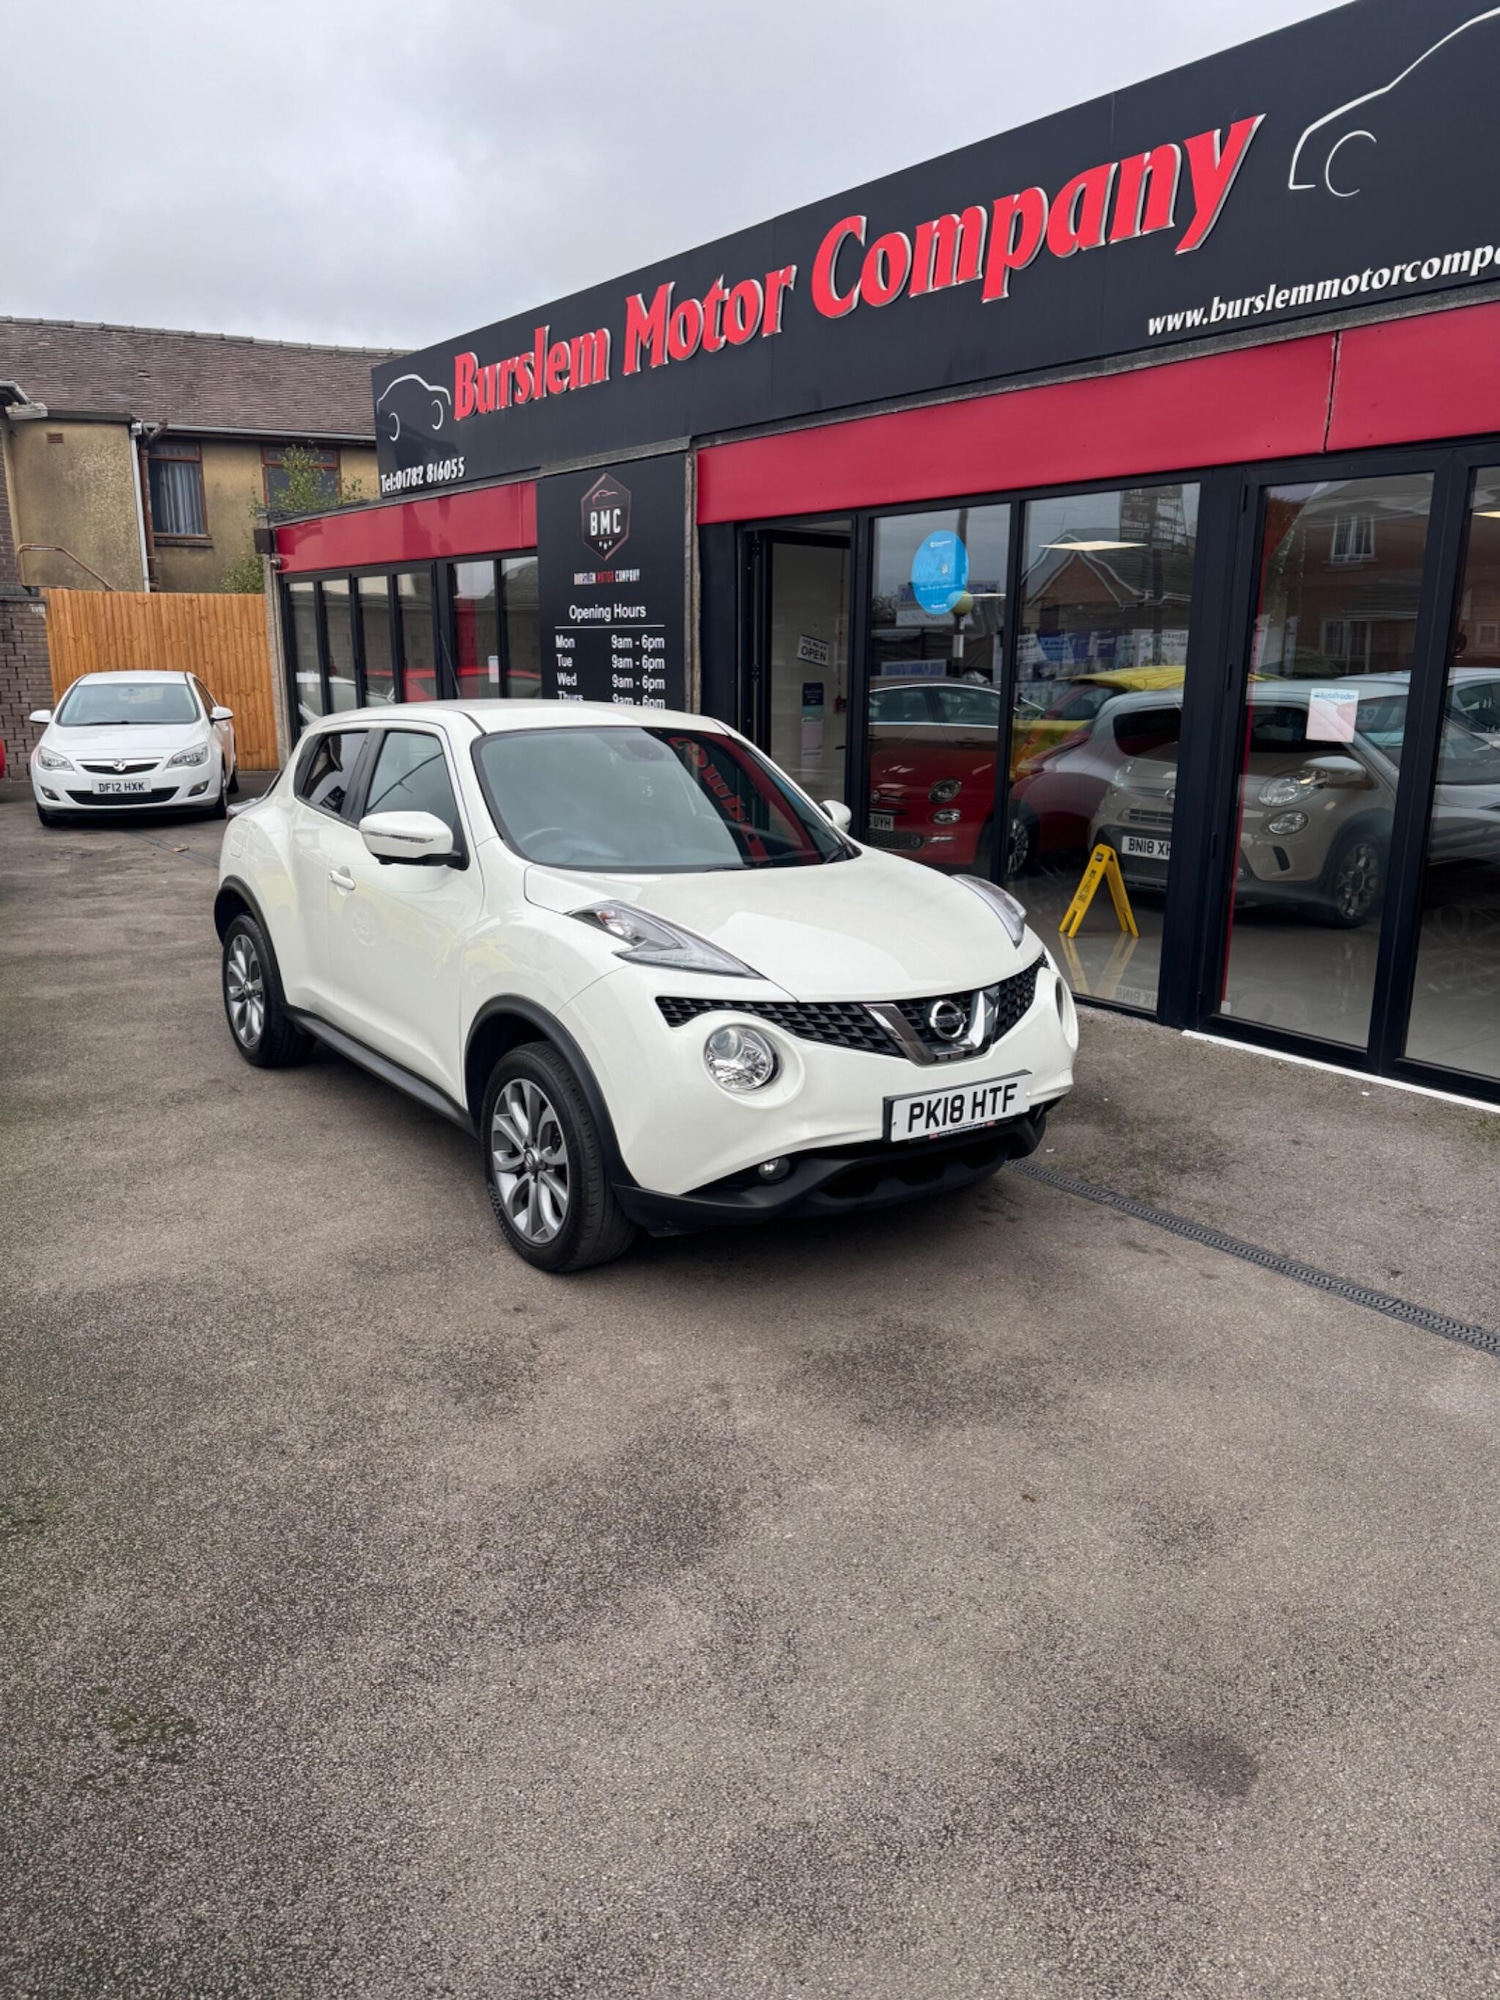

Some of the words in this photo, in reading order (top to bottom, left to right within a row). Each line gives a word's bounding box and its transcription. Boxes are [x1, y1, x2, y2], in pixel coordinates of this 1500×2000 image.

[453, 325, 611, 421] Burslem
[622, 264, 797, 376] Motor
[811, 113, 1266, 319] Company
[381, 464, 424, 493] Tel:01782
[426, 456, 465, 484] 816055
[590, 508, 621, 536] BMC
[569, 604, 611, 622] Opening
[613, 603, 647, 618] Hours
[555, 635, 575, 648] Mon
[611, 634, 633, 649] 9am
[641, 634, 665, 652] 6pm
[801, 645, 827, 661] OPEN
[556, 654, 573, 667] Tue
[611, 654, 633, 669] 9am
[641, 654, 665, 672] 6pm
[557, 672, 577, 686] Wed
[612, 674, 634, 688] 9am
[642, 675, 666, 692] 6pm
[98, 783, 121, 792] DF12
[124, 782, 145, 791] HXK
[873, 815, 891, 828] UYH
[1128, 838, 1154, 854] BN18
[908, 1094, 965, 1132] PK18
[971, 1083, 1017, 1119] HTF
